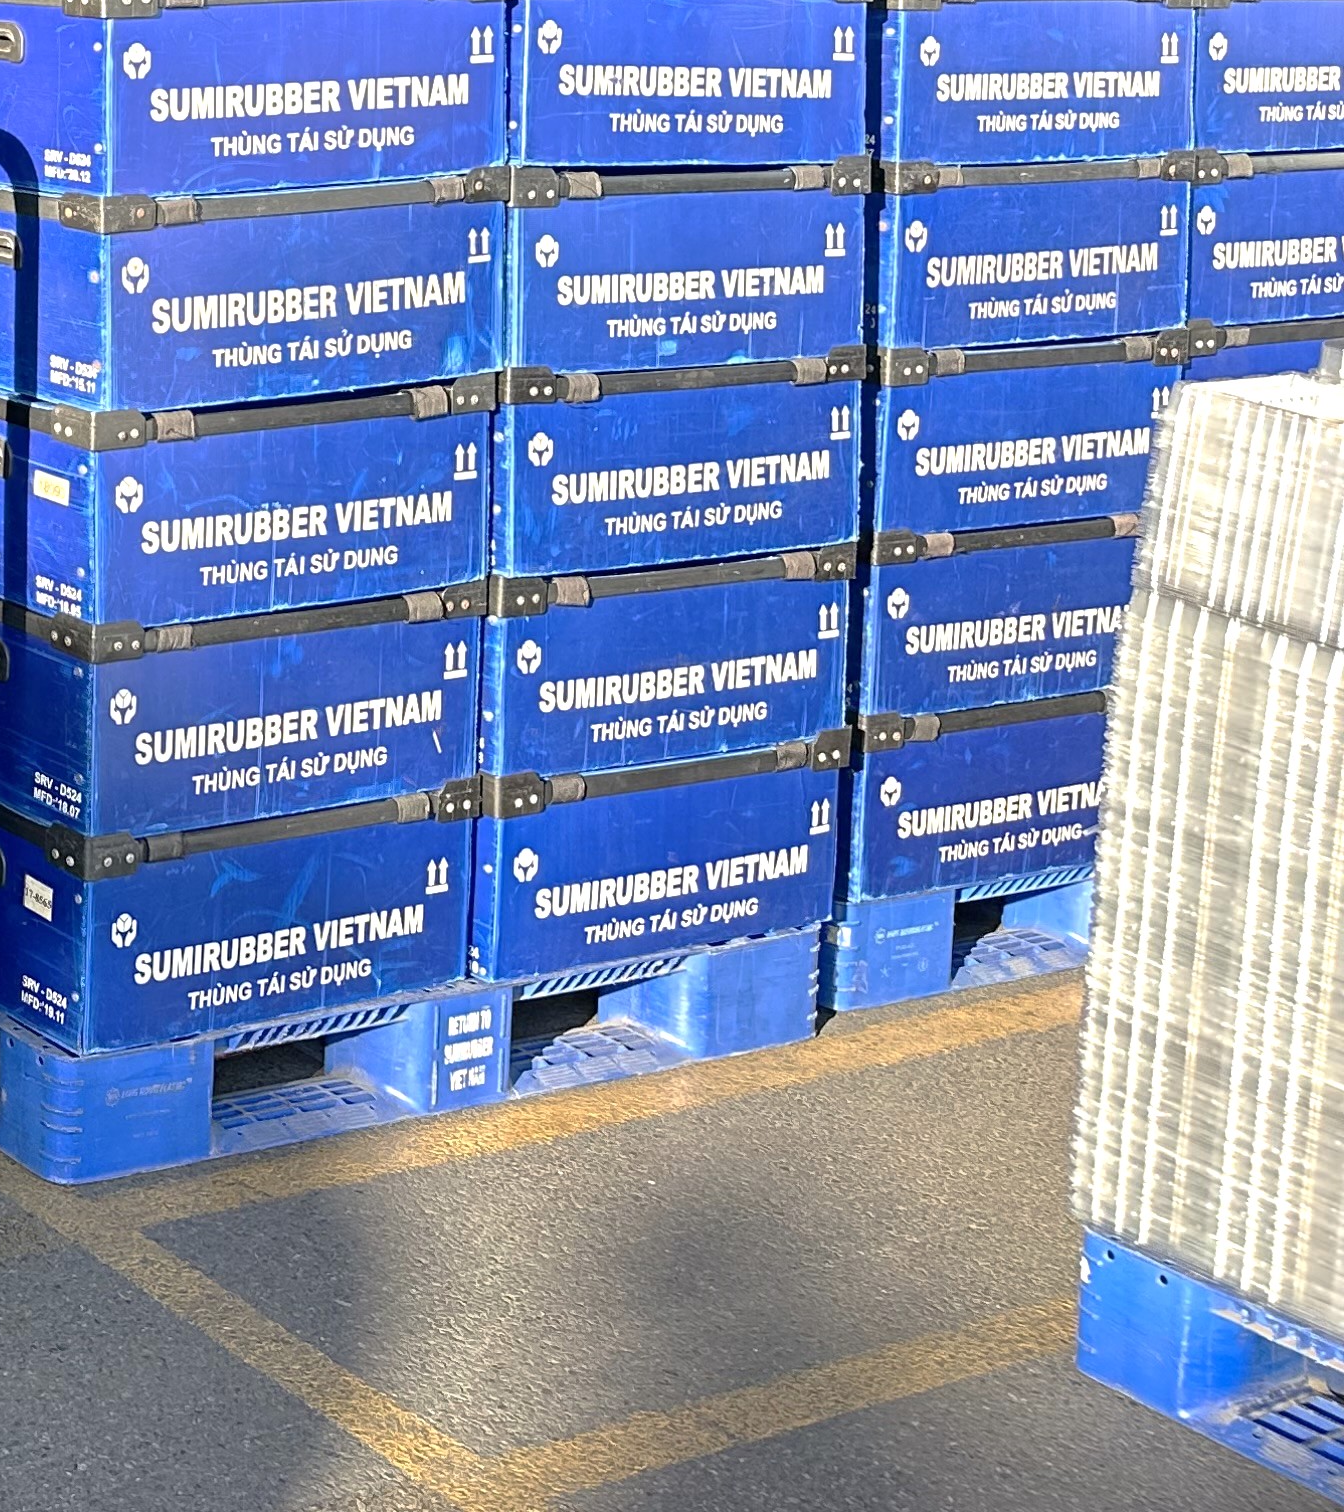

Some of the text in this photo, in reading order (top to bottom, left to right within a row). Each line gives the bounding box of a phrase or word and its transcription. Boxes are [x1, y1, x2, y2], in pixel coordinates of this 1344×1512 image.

[150, 74, 468, 122] SUMIRUBBER VIETNAM
[559, 64, 831, 98] SUMIRUBBER VIETNAM
[937, 71, 1160, 102] SUMIRUBBER VIETNAM
[1224, 66, 1340, 94] SUMIRUBBER
[609, 109, 670, 132] THÙNG
[675, 110, 702, 132] TÁI
[736, 114, 783, 137] DỤNG
[977, 111, 1027, 132] THÙNG
[1030, 110, 1052, 130] TÁI
[1079, 112, 1120, 132] DỤNG
[210, 130, 281, 156] THÙNG
[287, 127, 318, 152] TÁI
[358, 126, 414, 151] DỤNG
[927, 243, 1158, 288] SUMIRUBBER VIETNAM
[1213, 237, 1337, 270] SUMIRUBBER
[152, 272, 465, 334] SUMIRUBBER VIETNAM
[558, 265, 824, 305] SUMIRUBBER VIETNAM
[607, 314, 666, 338] THÙNG
[670, 312, 697, 334] TÁI
[729, 312, 776, 334] DỤNG
[969, 297, 1020, 319] THÙNG
[1024, 294, 1048, 315] TÁI
[1075, 292, 1118, 315] DỤNG
[212, 342, 282, 368] THÙNG
[287, 336, 319, 361] TÁI
[357, 330, 412, 358] DỤNG
[916, 428, 1150, 476] SUMIRUBBER VIETNAM
[552, 450, 829, 505] SUMIRUBBER VIETNAM
[958, 482, 1010, 504] THÙNG
[1014, 477, 1038, 498] TÁI
[1066, 474, 1107, 496] DỤNG
[141, 491, 452, 554] SUMIRUBBER VIETNAM
[605, 512, 666, 536] THÙNG
[671, 506, 700, 529] TÁI
[734, 501, 782, 525] DỤNG
[200, 560, 268, 586] THÙNG
[273, 553, 305, 577] TÁI
[906, 605, 1130, 654] SUMIRUBBER VIETNA
[539, 649, 816, 712] SUMIRUBBER VIETNAM
[948, 660, 999, 682] THÙNG
[1003, 654, 1027, 676] TÁI
[1055, 650, 1096, 672] DỤNG
[135, 690, 441, 764] SUMIRUBBER VIETNAM
[590, 716, 652, 742] THÙNG
[657, 710, 684, 733] TÁI
[718, 702, 767, 727] DỤNG
[34, 771, 54, 789] SRV
[60, 783, 82, 804] D524
[192, 766, 260, 794] THÙNG
[266, 757, 296, 783] TÁI
[334, 746, 387, 774] DỤNG
[898, 780, 1106, 838] SUMIRUBBER VIETNA
[939, 840, 989, 862] THÙNG
[993, 832, 1015, 854] TÁI
[1042, 824, 1082, 846] DỤNG
[535, 845, 808, 918] SUMIRUBBER VIETNAM
[584, 918, 645, 944] THÙNG
[650, 909, 677, 932] TÁI
[710, 898, 758, 923] DỤNG
[134, 904, 423, 984] SUMIRUBBER VIETNAM
[21, 974, 40, 994] SRV
[45, 987, 67, 1010] D524
[188, 982, 252, 1010] THÙNG
[257, 972, 285, 996] TÁI
[320, 959, 371, 986] DỤNG
